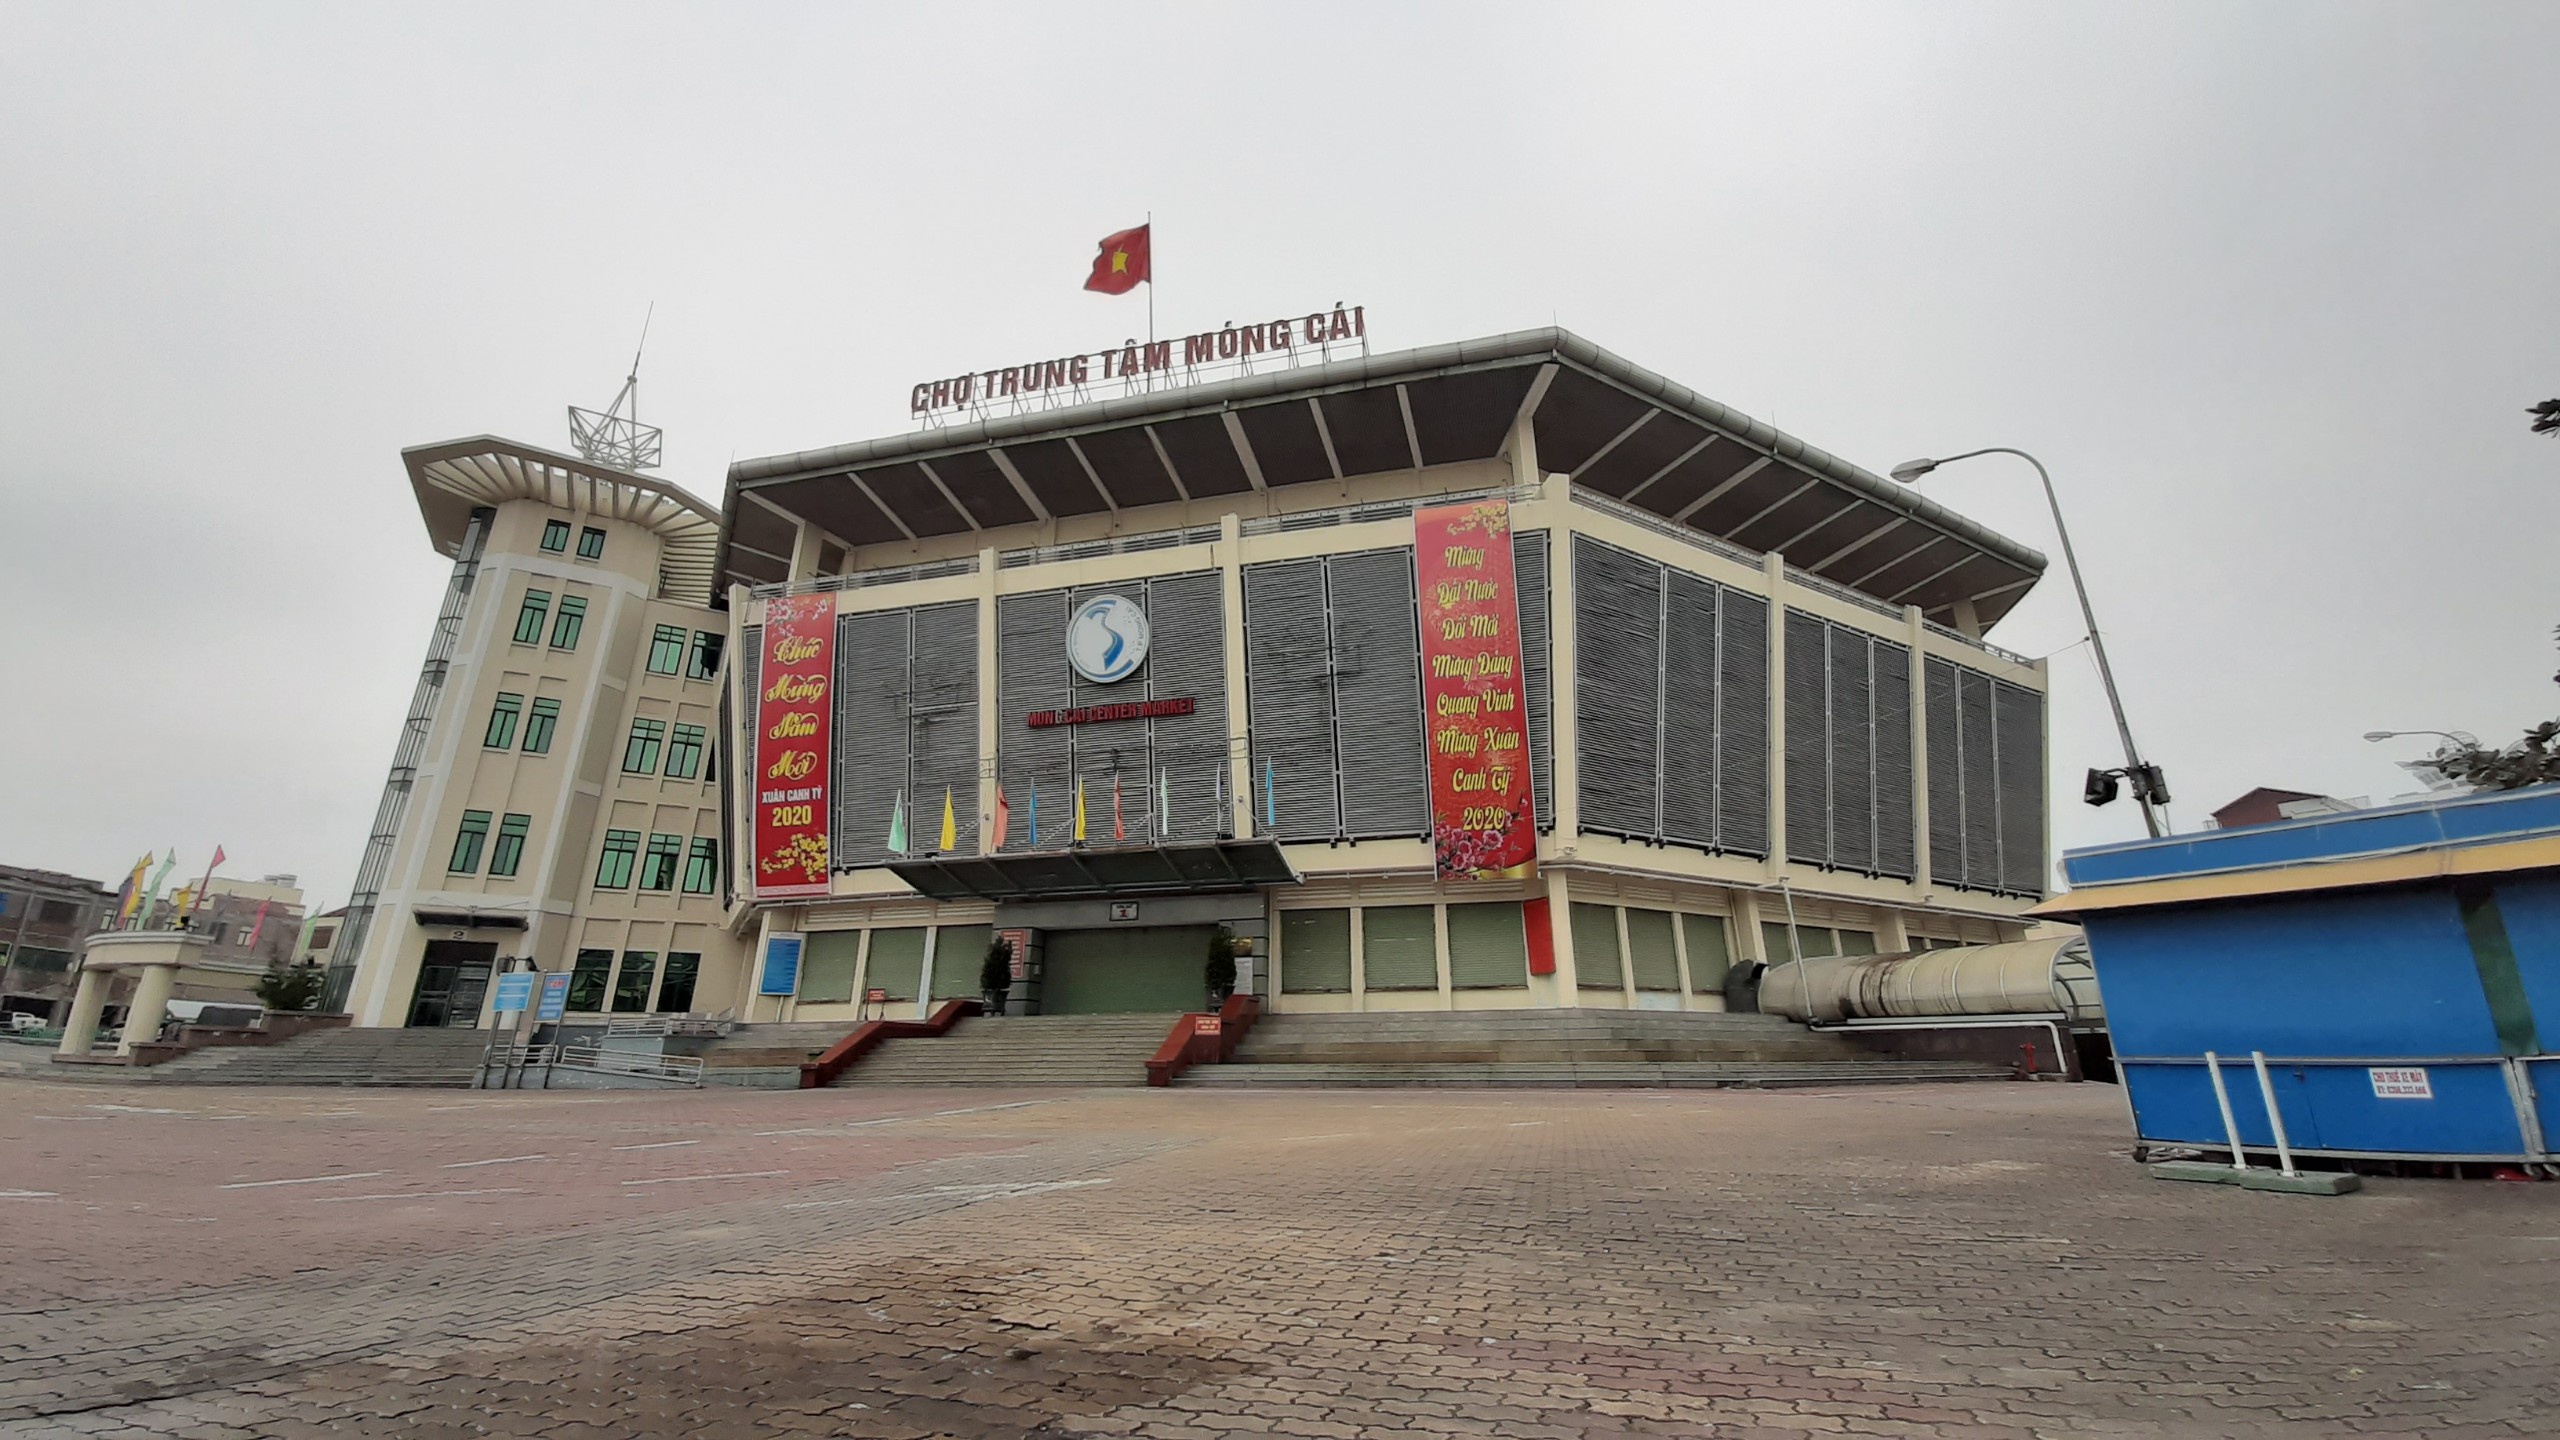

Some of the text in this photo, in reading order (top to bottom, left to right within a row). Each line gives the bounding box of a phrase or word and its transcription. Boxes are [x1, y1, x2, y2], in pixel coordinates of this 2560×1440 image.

[911, 301, 1365, 412] CHỢ TRUNG TÂM MÓNG CÁI
[1437, 577, 1499, 605] Đất Nước
[1469, 613, 1499, 639] Mới
[1432, 650, 1514, 682] Mừng Đảng
[1088, 702, 1137, 723] CENTER
[1139, 697, 1195, 718] MARKET
[1436, 687, 1515, 719] Quang Vinh
[769, 711, 820, 740] Năm
[1484, 726, 1520, 752] Xuân
[1452, 767, 1487, 792] Canh
[762, 788, 785, 804] XUÂN
[786, 788, 810, 802] CANH
[771, 804, 812, 827] 2020
[1463, 806, 1506, 831] 2020
[452, 930, 465, 940] 2
